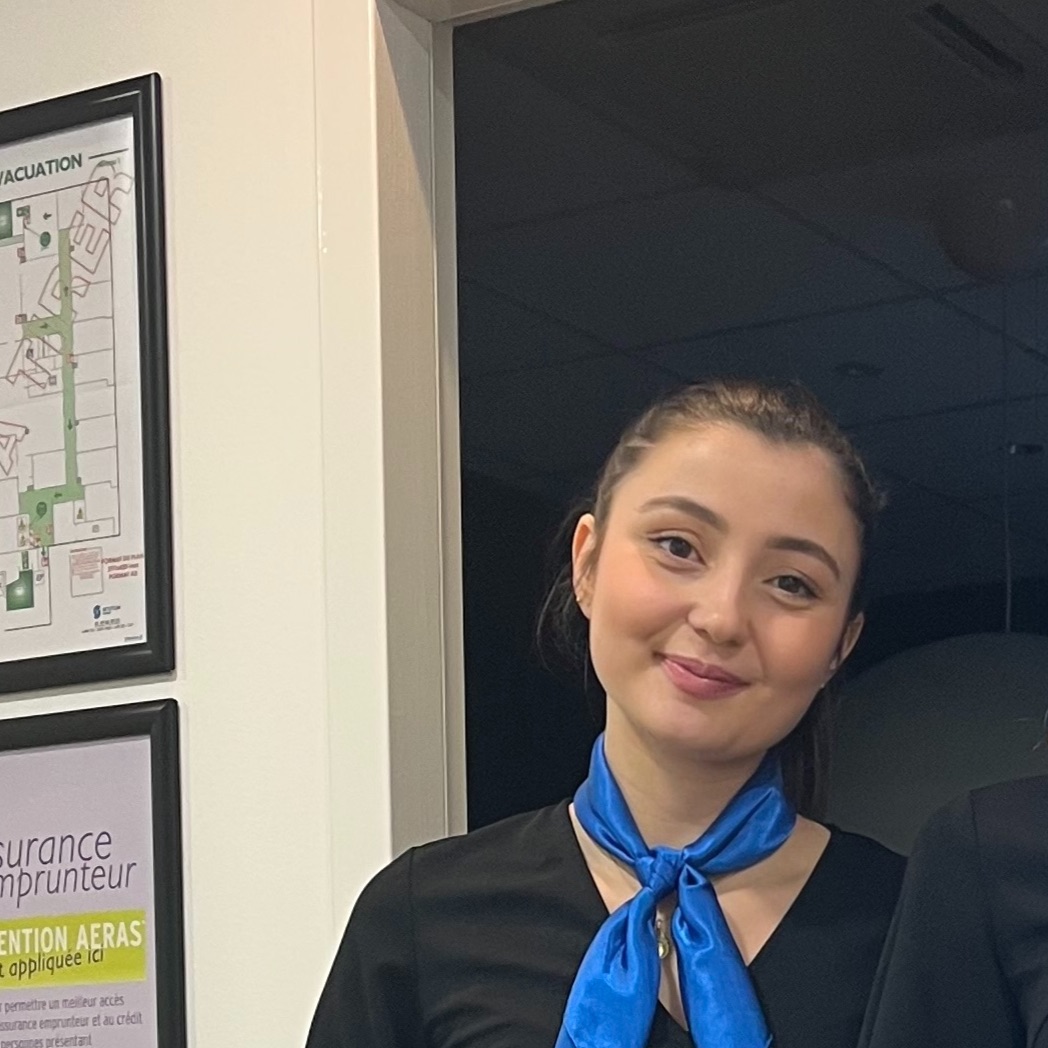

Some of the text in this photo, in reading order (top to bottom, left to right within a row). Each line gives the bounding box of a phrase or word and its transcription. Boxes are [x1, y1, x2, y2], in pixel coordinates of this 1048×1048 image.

[9, 948, 82, 980] appliquée
[87, 943, 104, 964] ici
[62, 995, 97, 1009] meilleur
[99, 993, 125, 1007] accès
[39, 1015, 89, 1030] emprunteur
[92, 1014, 101, 1027] et
[103, 1014, 115, 1026] au
[117, 1010, 143, 1026] crédit
